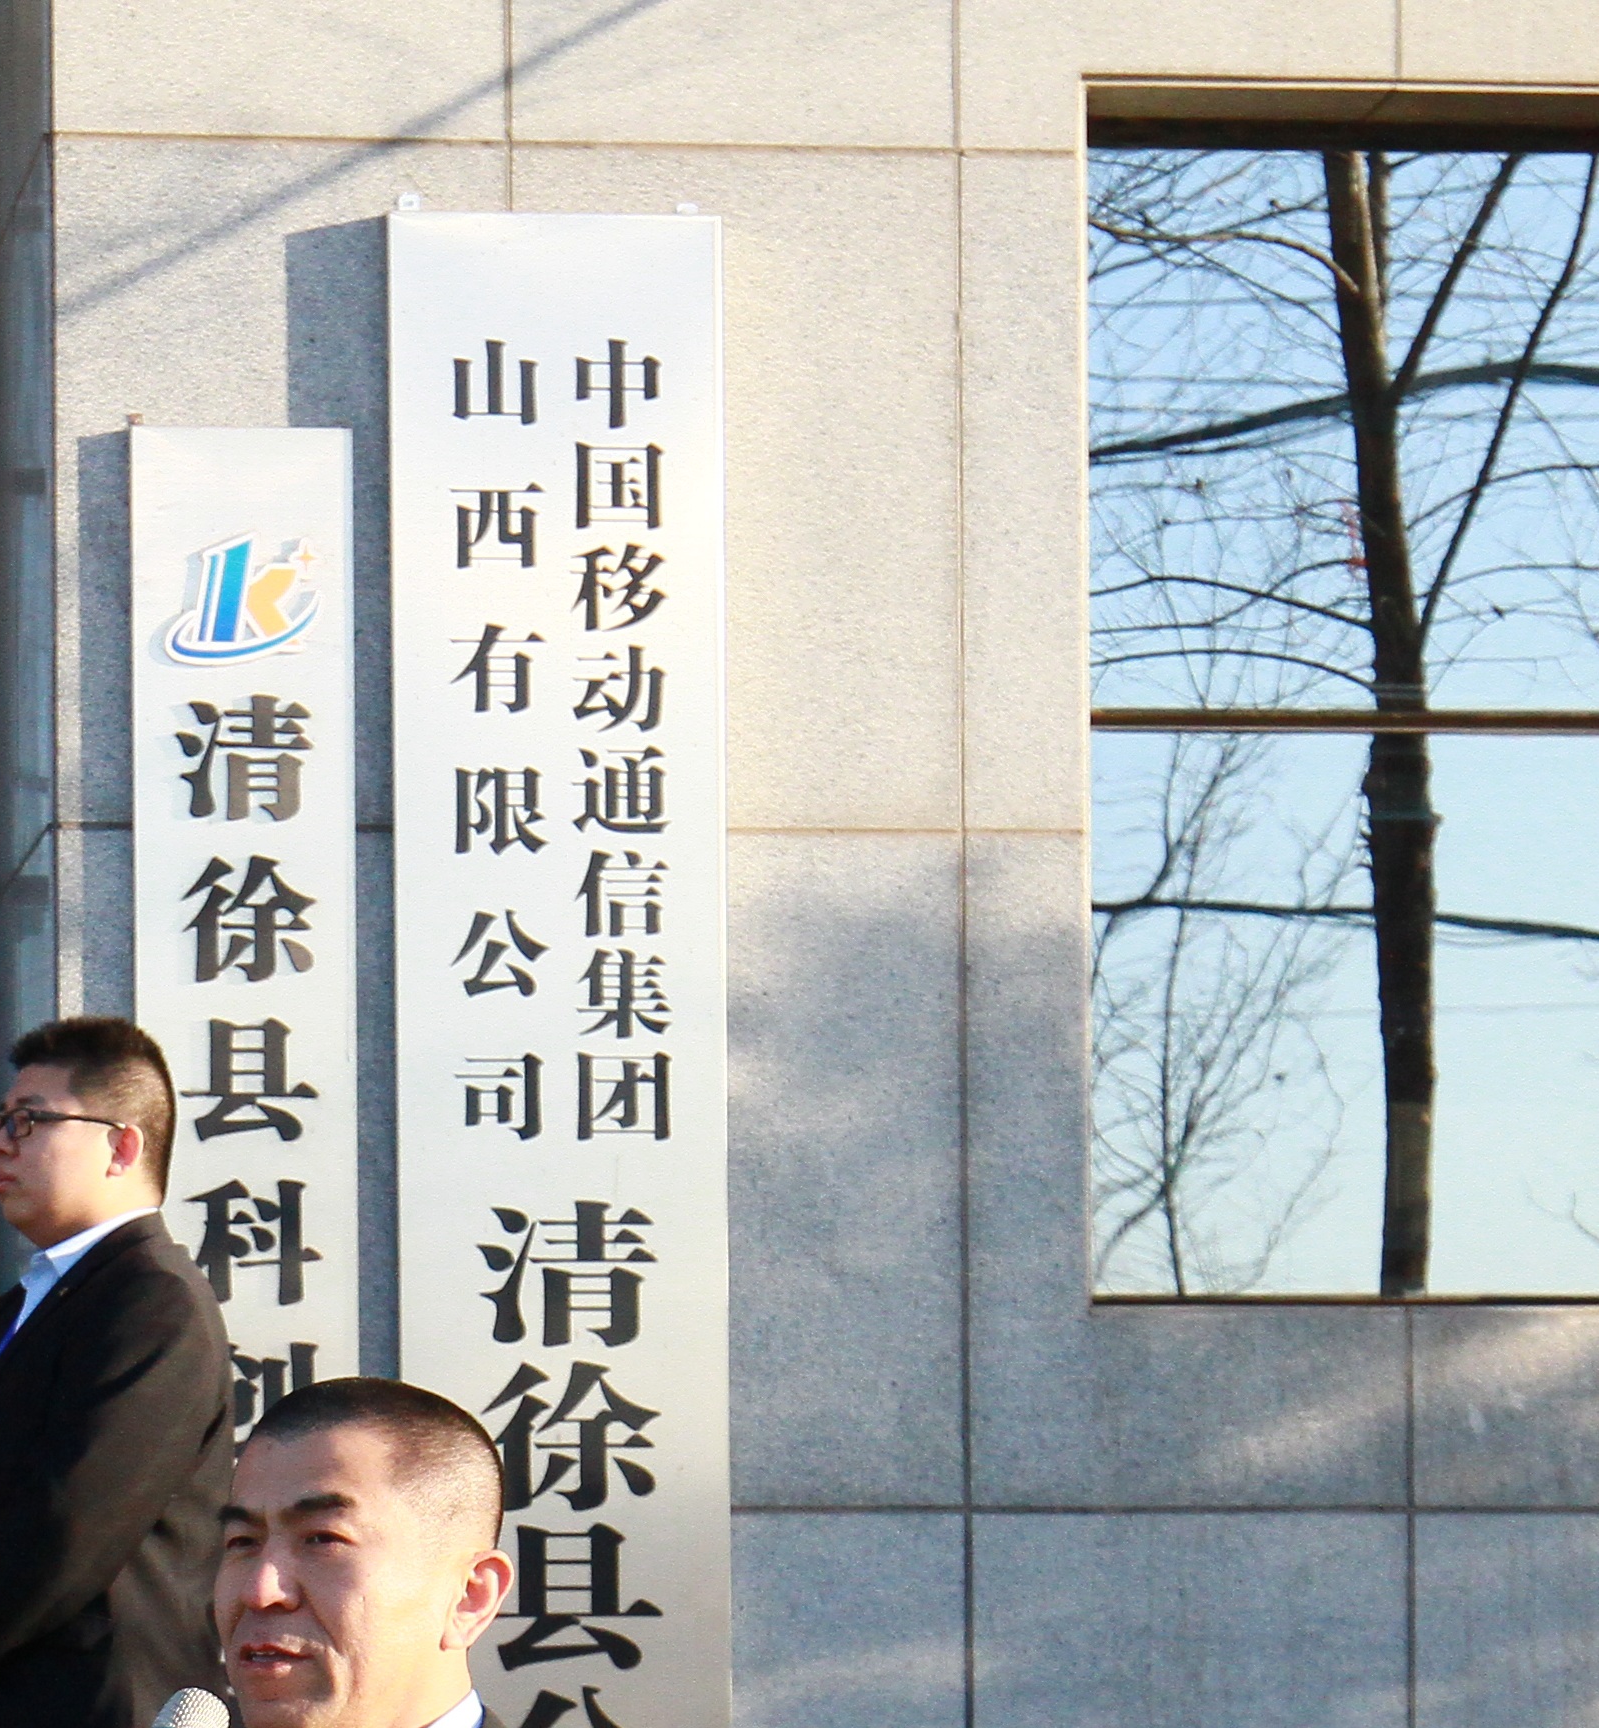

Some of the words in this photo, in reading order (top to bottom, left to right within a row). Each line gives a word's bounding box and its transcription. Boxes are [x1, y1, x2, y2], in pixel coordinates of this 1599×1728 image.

[450, 339, 550, 1142] 山西有限公司
[570, 339, 674, 1142] 中国移动通信集团
